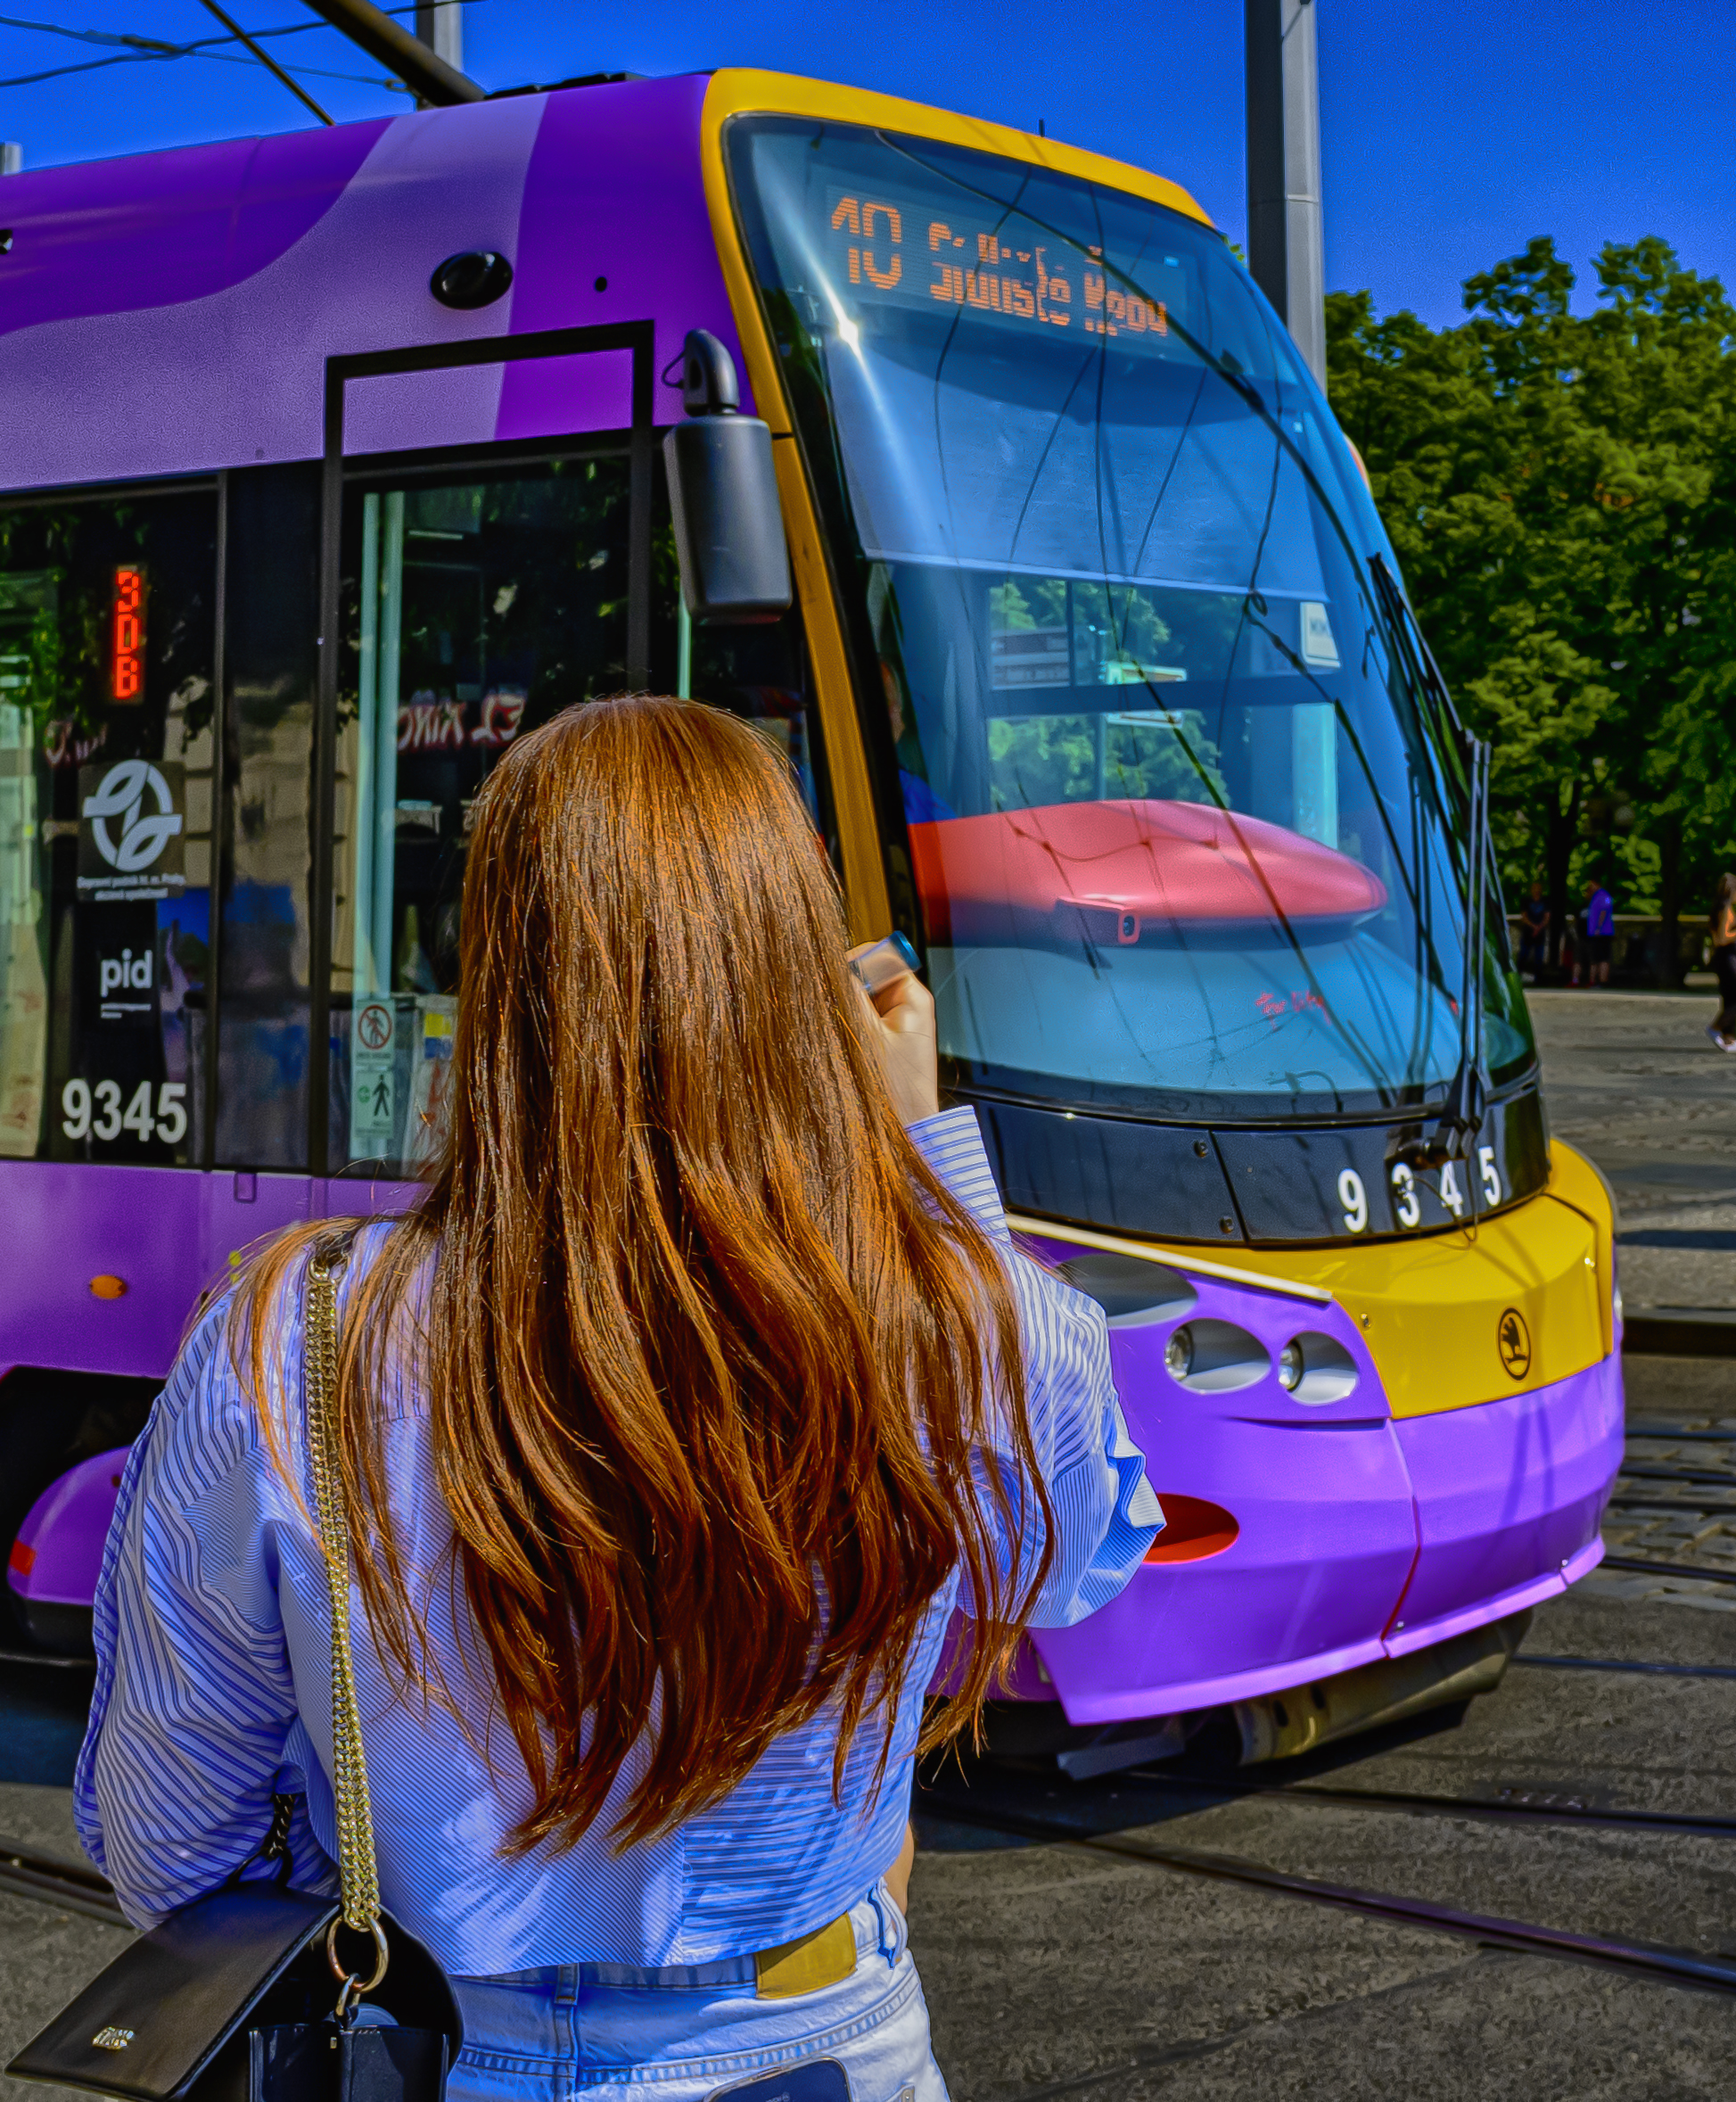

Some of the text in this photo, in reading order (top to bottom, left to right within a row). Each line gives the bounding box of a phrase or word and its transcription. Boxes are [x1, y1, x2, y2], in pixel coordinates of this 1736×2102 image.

[831, 197, 902, 290] 10
[101, 948, 152, 997] pid
[62, 1078, 187, 1144] 9345
[1337, 1145, 1502, 1233] 9345
